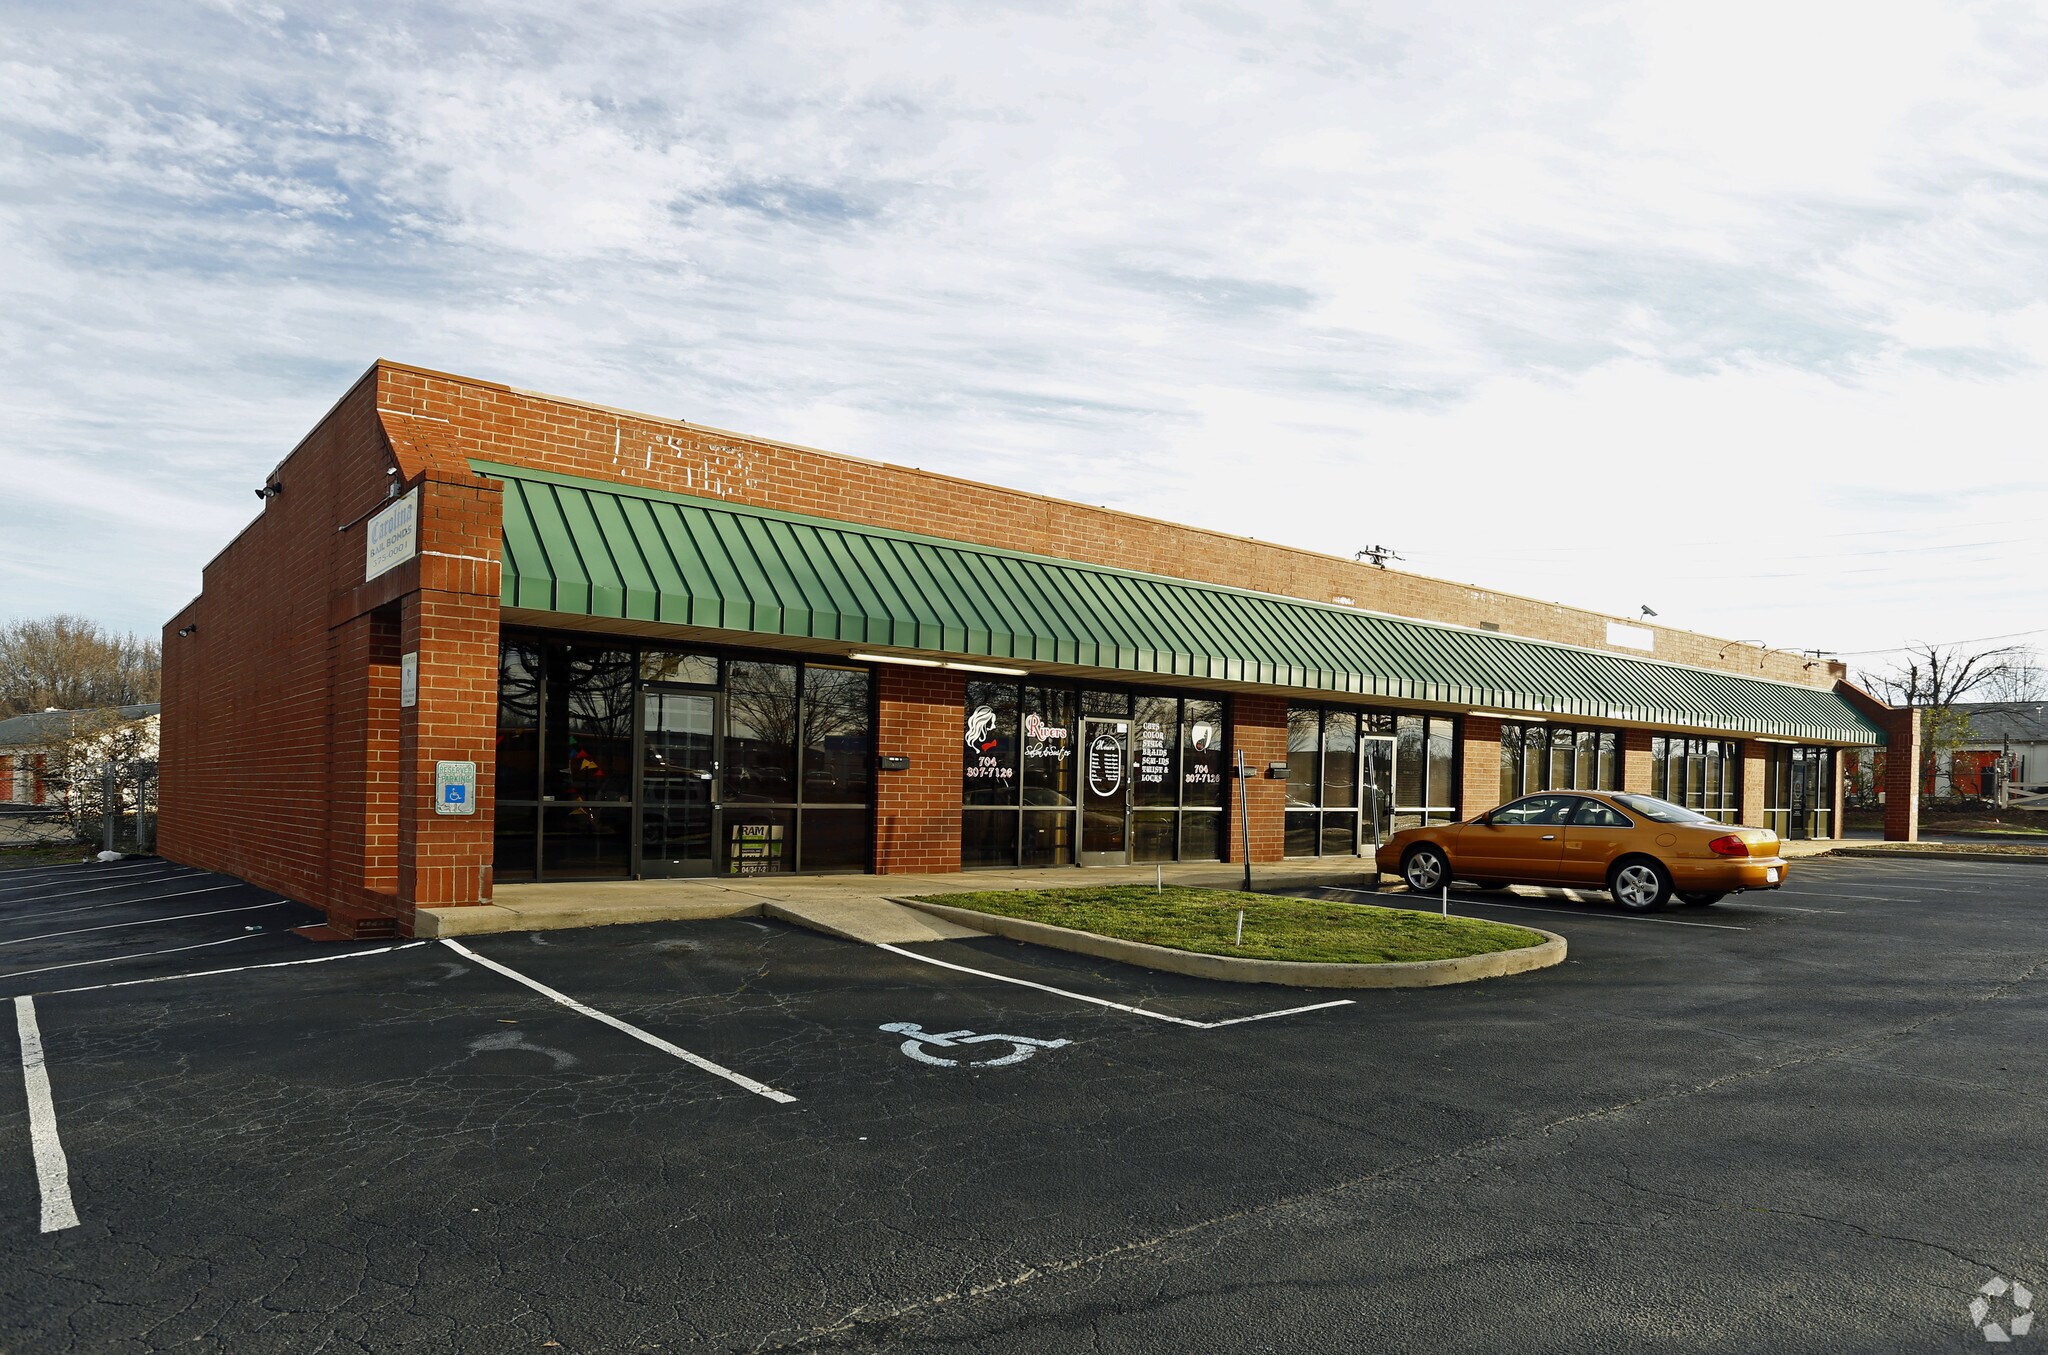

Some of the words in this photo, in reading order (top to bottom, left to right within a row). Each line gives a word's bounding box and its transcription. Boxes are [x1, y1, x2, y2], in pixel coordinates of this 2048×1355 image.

[371, 504, 413, 545] Carolina
[370, 545, 386, 558] BAIL
[386, 525, 412, 548] BONDS
[1025, 712, 1067, 741] Rivers
[1142, 731, 1164, 740] COLOR
[1095, 739, 1115, 751] Hours
[1142, 748, 1167, 757] BRAIDS
[978, 756, 997, 767] 704
[1194, 764, 1209, 774] 704
[442, 775, 471, 783] PARKING
[742, 826, 765, 836] RAM
